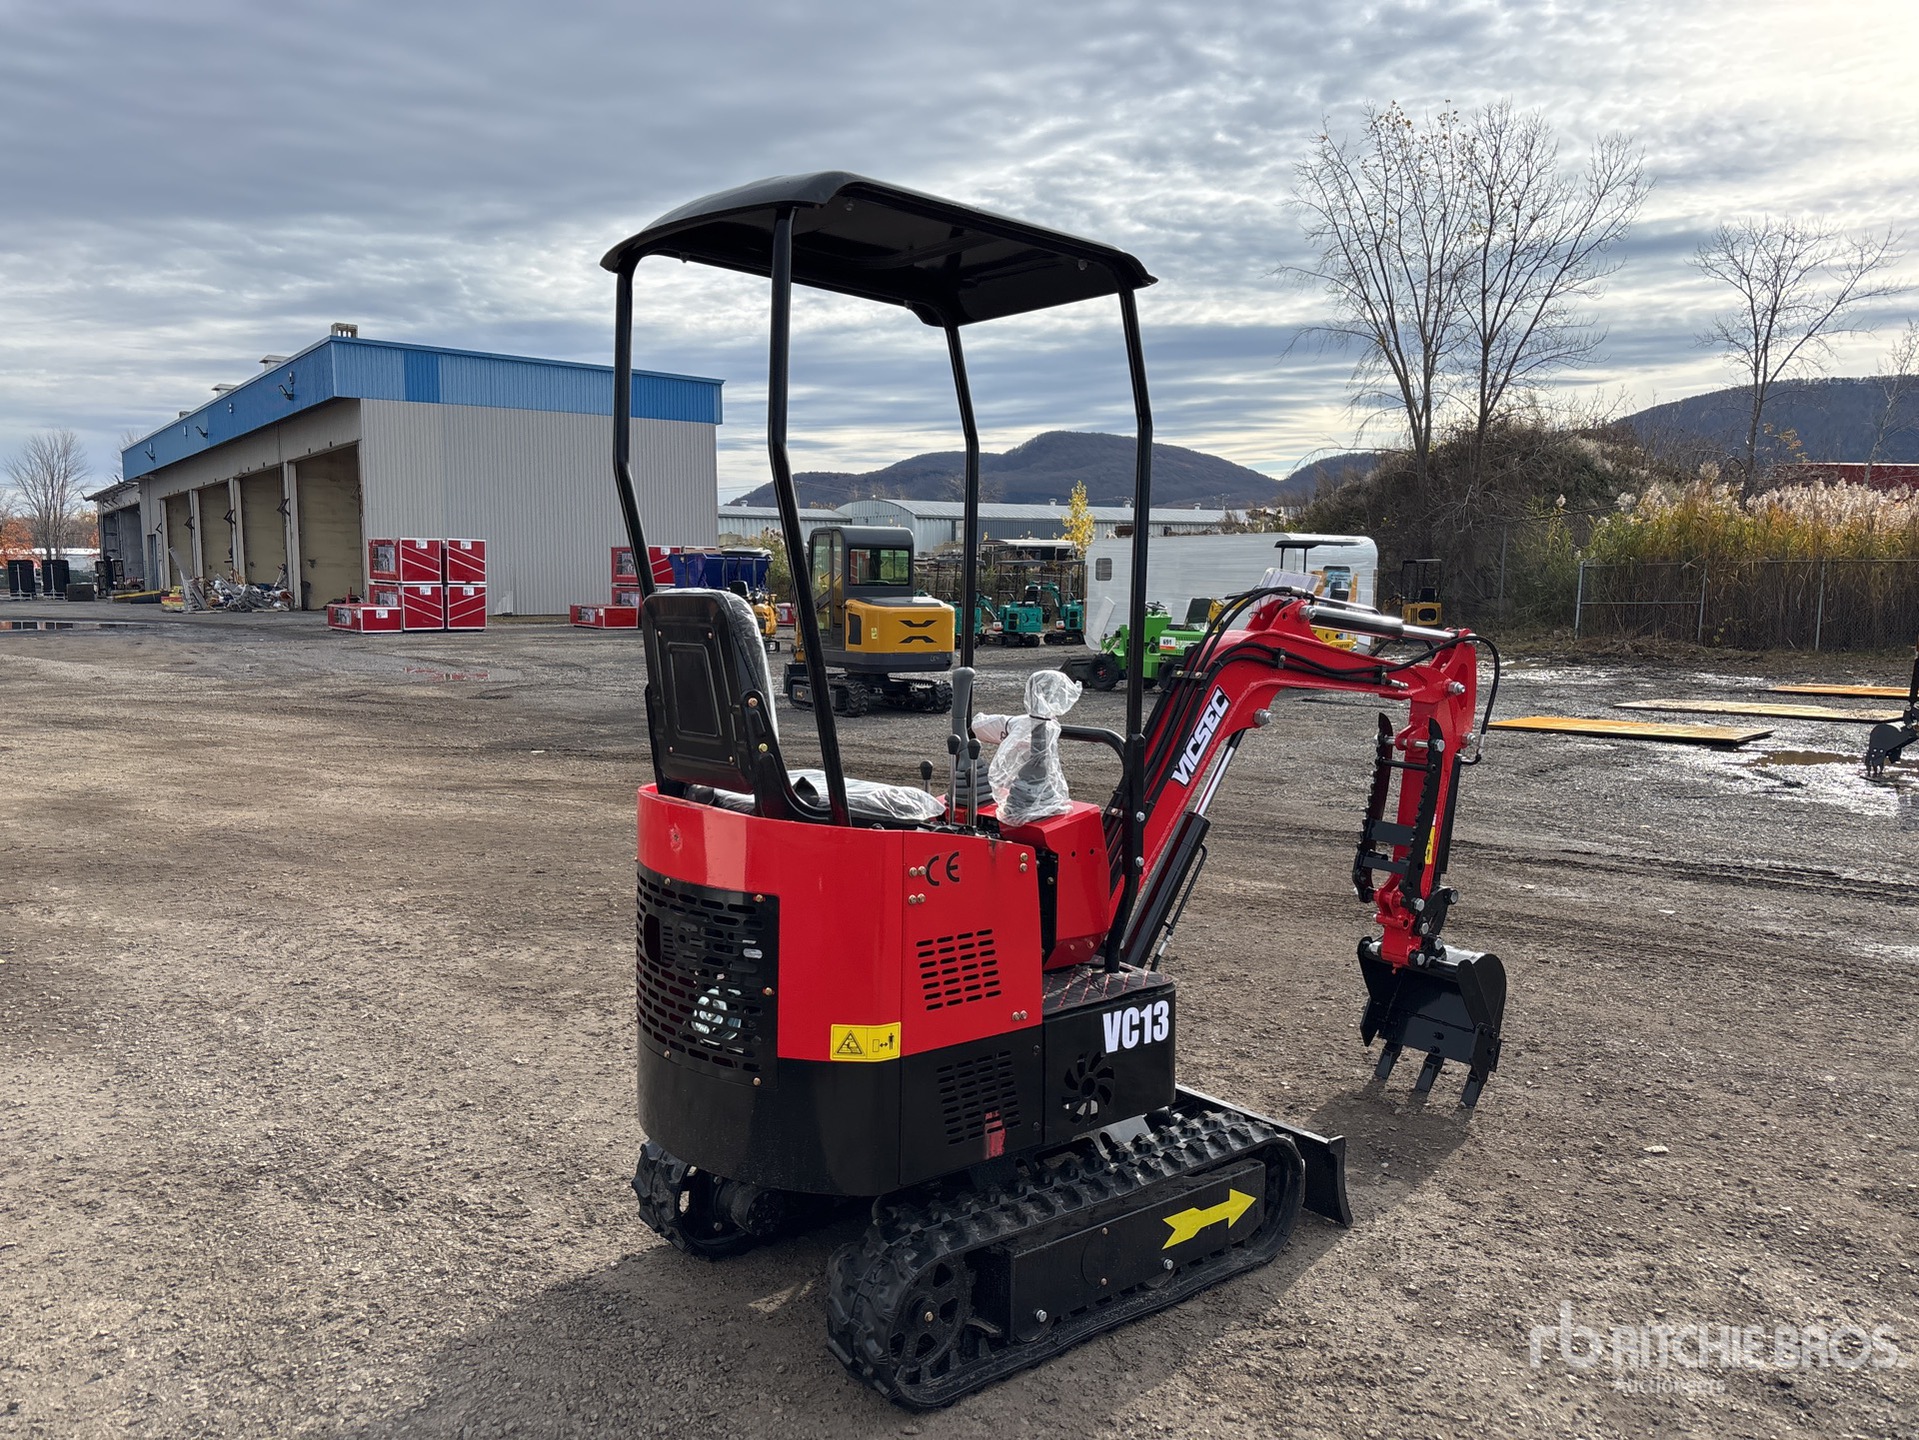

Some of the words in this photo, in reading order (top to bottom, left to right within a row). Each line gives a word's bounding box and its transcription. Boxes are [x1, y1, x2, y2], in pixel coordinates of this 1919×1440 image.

[1170, 687, 1230, 786] VICSEC
[926, 851, 960, 886] CE
[1102, 1000, 1169, 1053] VC13
